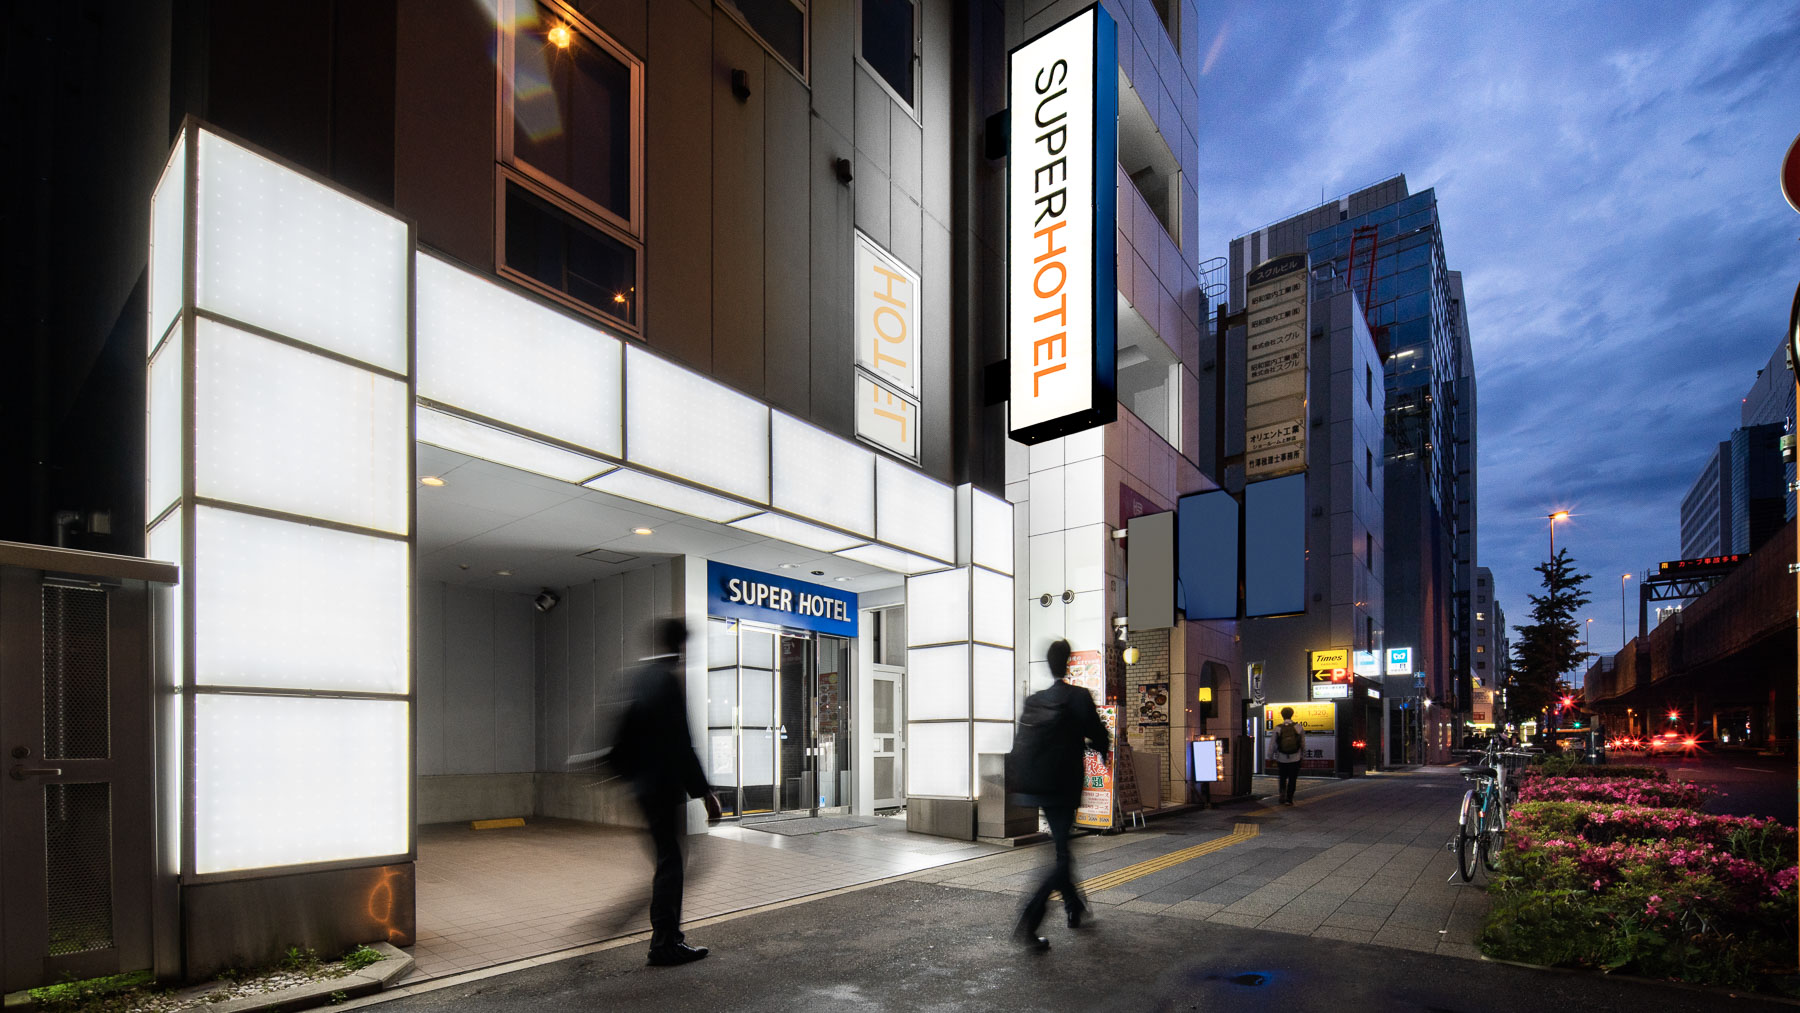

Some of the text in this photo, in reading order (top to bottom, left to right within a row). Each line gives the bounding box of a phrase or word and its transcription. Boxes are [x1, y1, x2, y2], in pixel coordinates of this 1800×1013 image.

[1250, 424, 1300, 443] オリエント工業
[1678, 555, 1739, 568] カーブ事故多発
[728, 578, 852, 623] SUPER HOTEL
[1316, 654, 1343, 662] Times
[1333, 668, 1346, 681] P
